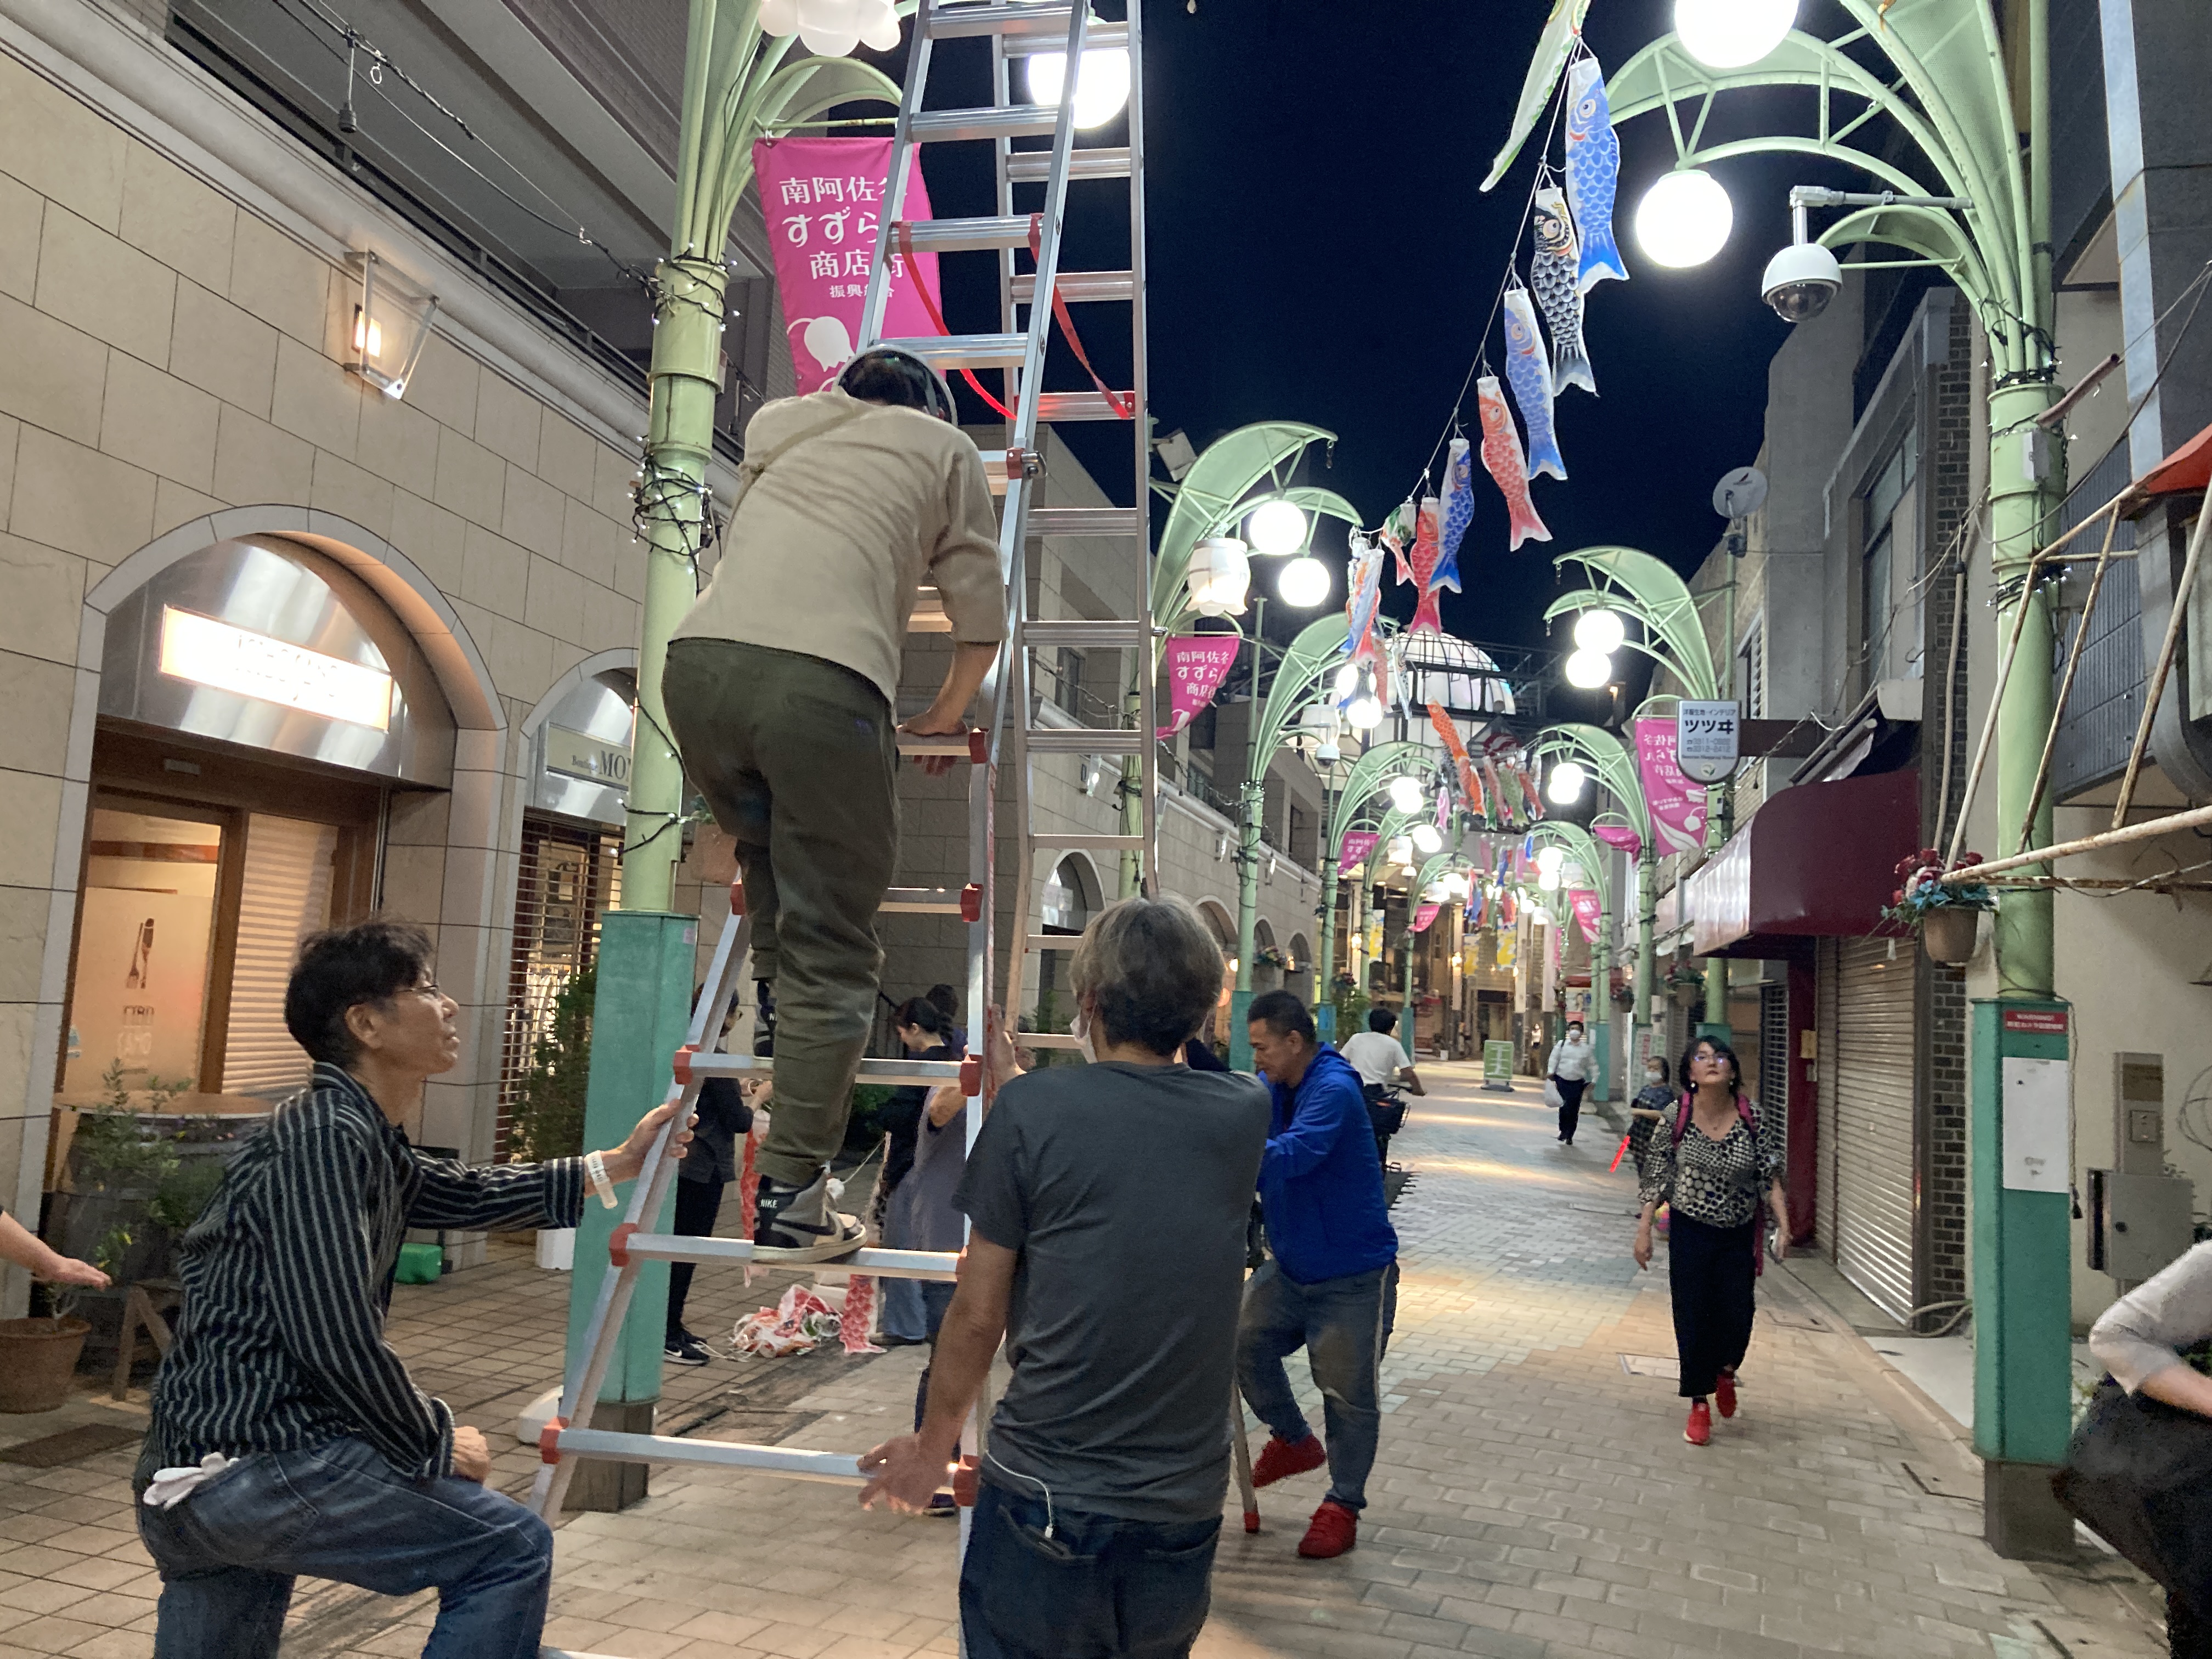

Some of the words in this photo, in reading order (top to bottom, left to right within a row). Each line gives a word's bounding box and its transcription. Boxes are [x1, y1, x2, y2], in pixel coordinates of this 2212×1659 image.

[782, 206, 903, 247] すずら
[760, 1199, 778, 1209] NIKE
